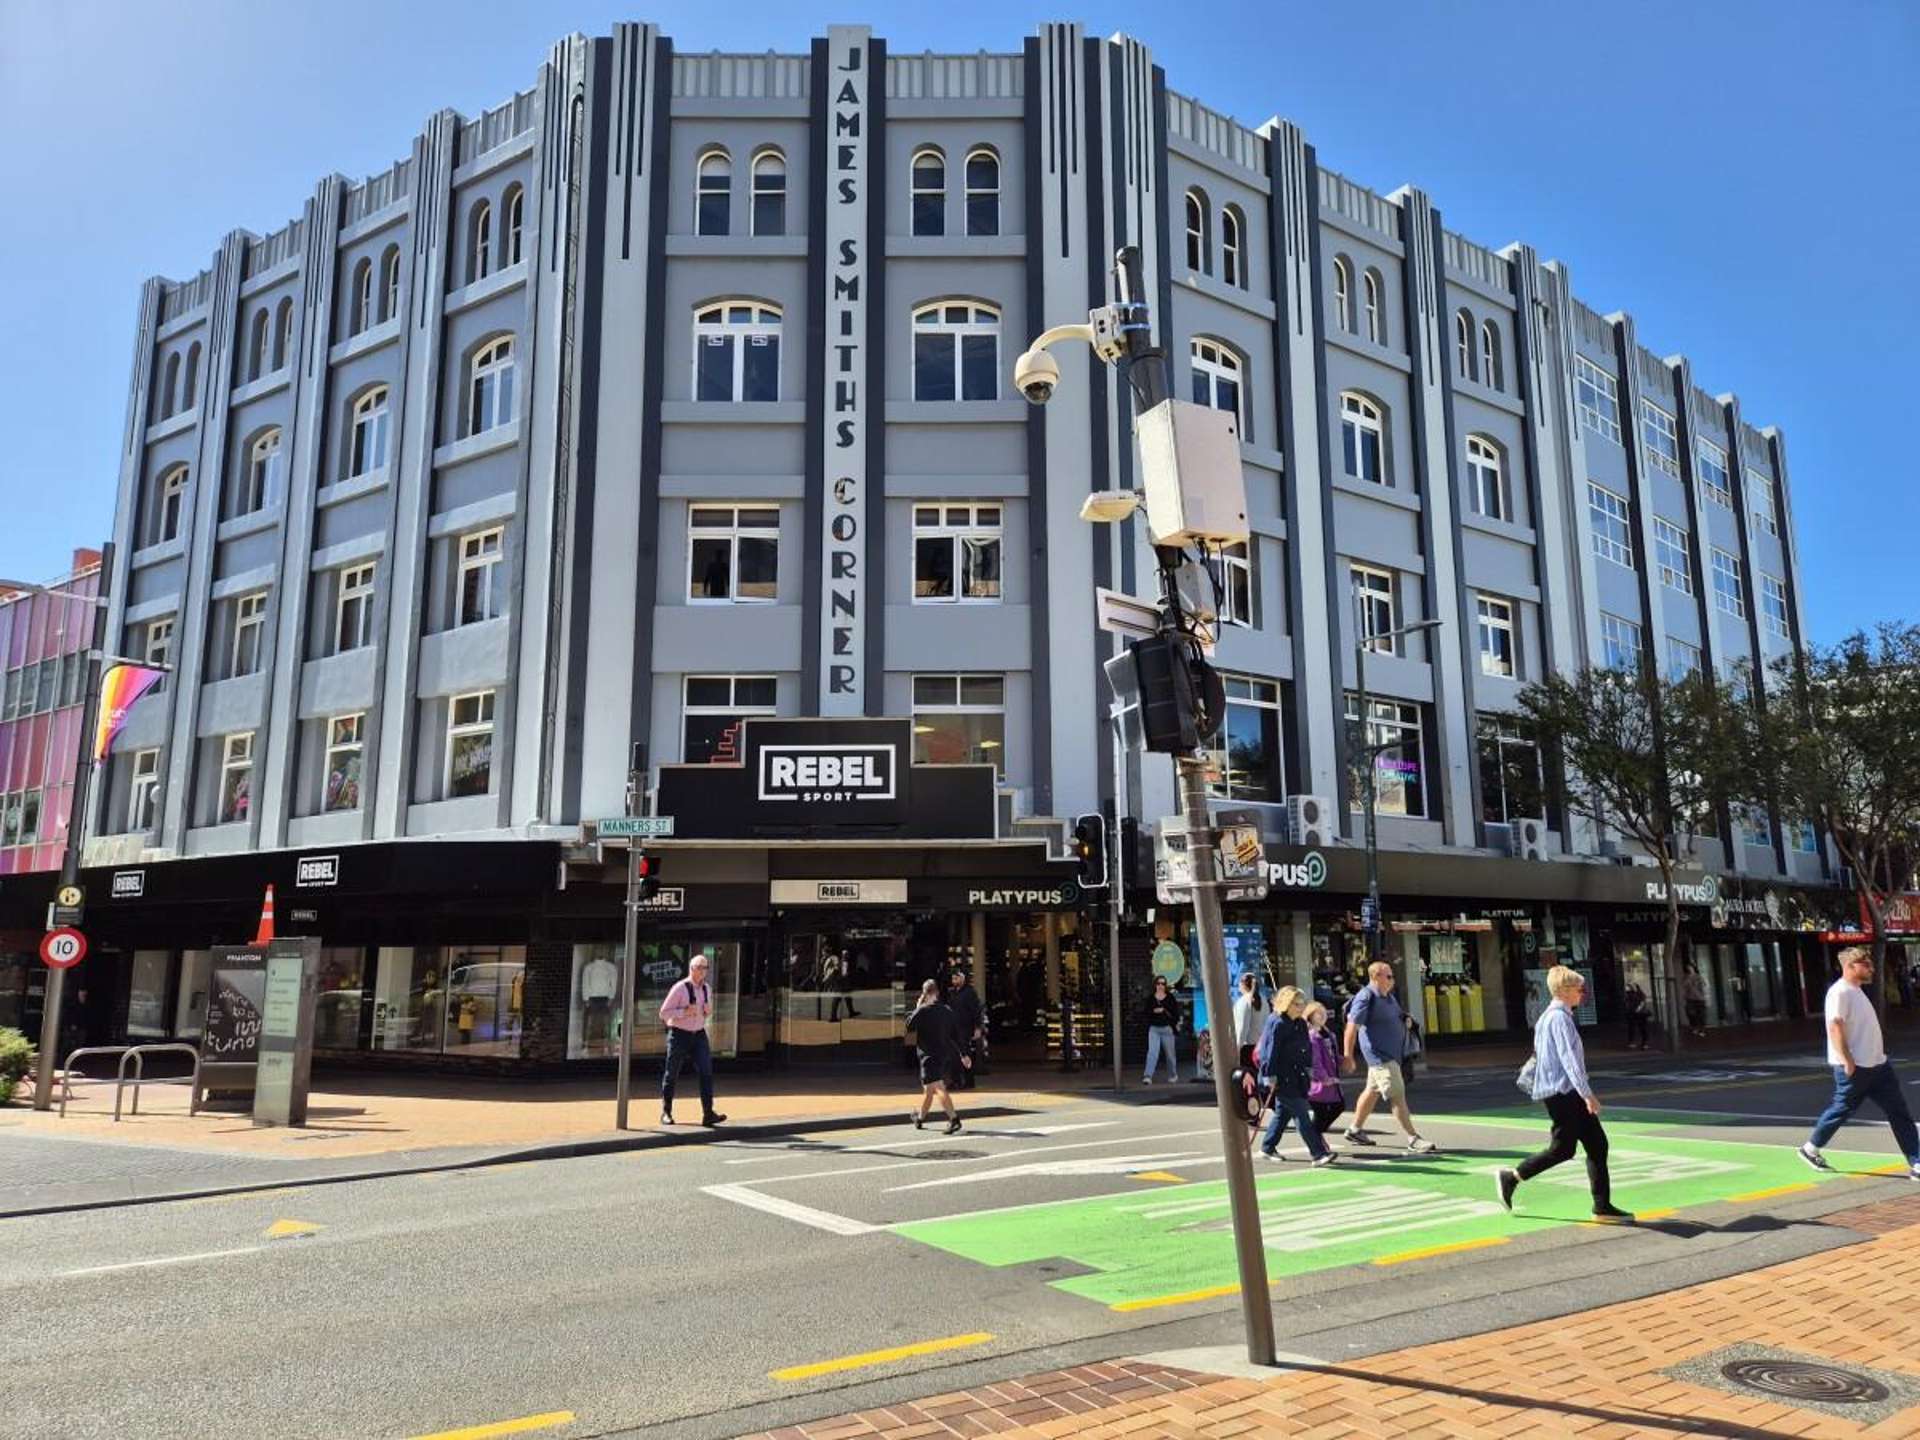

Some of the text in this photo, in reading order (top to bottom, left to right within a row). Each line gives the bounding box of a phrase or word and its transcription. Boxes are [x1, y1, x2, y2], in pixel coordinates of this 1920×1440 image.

[829, 47, 861, 694] JAMES SMITHS CORNER
[771, 755, 884, 788] REBEL
[802, 792, 853, 801] SPORT
[602, 820, 667, 832] MANNERS ST
[301, 861, 334, 880] REBEL
[116, 876, 140, 891] REBEL
[821, 886, 856, 897] REBEL
[968, 889, 1063, 905] PLATYPUS
[56, 940, 73, 954] 10
